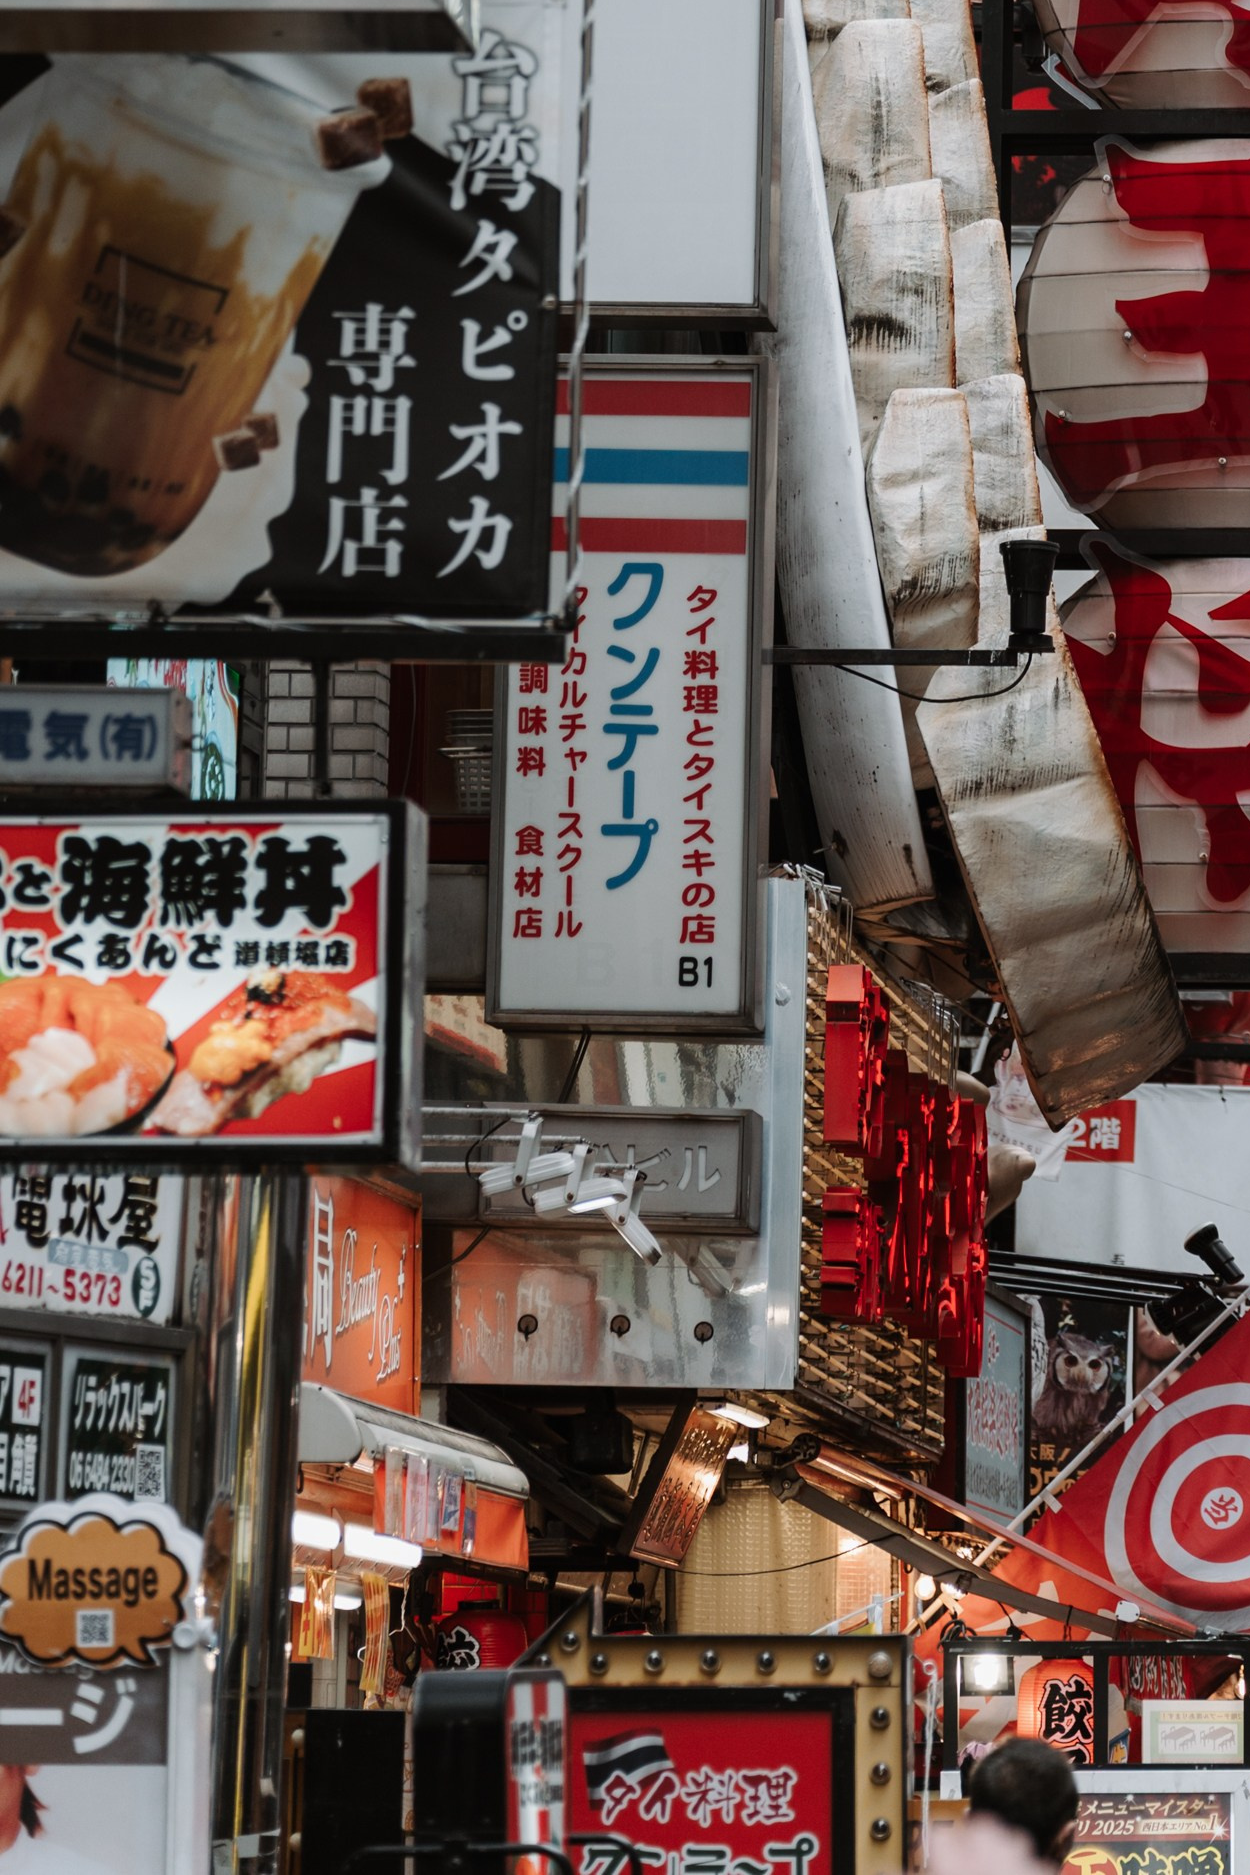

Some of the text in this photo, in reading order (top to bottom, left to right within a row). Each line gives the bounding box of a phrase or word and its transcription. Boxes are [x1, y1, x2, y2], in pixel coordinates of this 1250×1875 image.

[437, 28, 541, 580] 台湾タピオカ
[317, 302, 418, 580] 専門店
[516, 661, 548, 777] 調味料
[600, 562, 665, 891] クンテープ
[678, 585, 719, 944] タイ料理とタイスキの店
[0, 835, 348, 929] と海鮮丼
[512, 825, 545, 939] 食材店
[678, 956, 714, 988] B1
[27, 1558, 159, 1608] Massage
[600, 1770, 799, 1827] タイ料理
[1092, 1819, 1136, 1836] 2025
